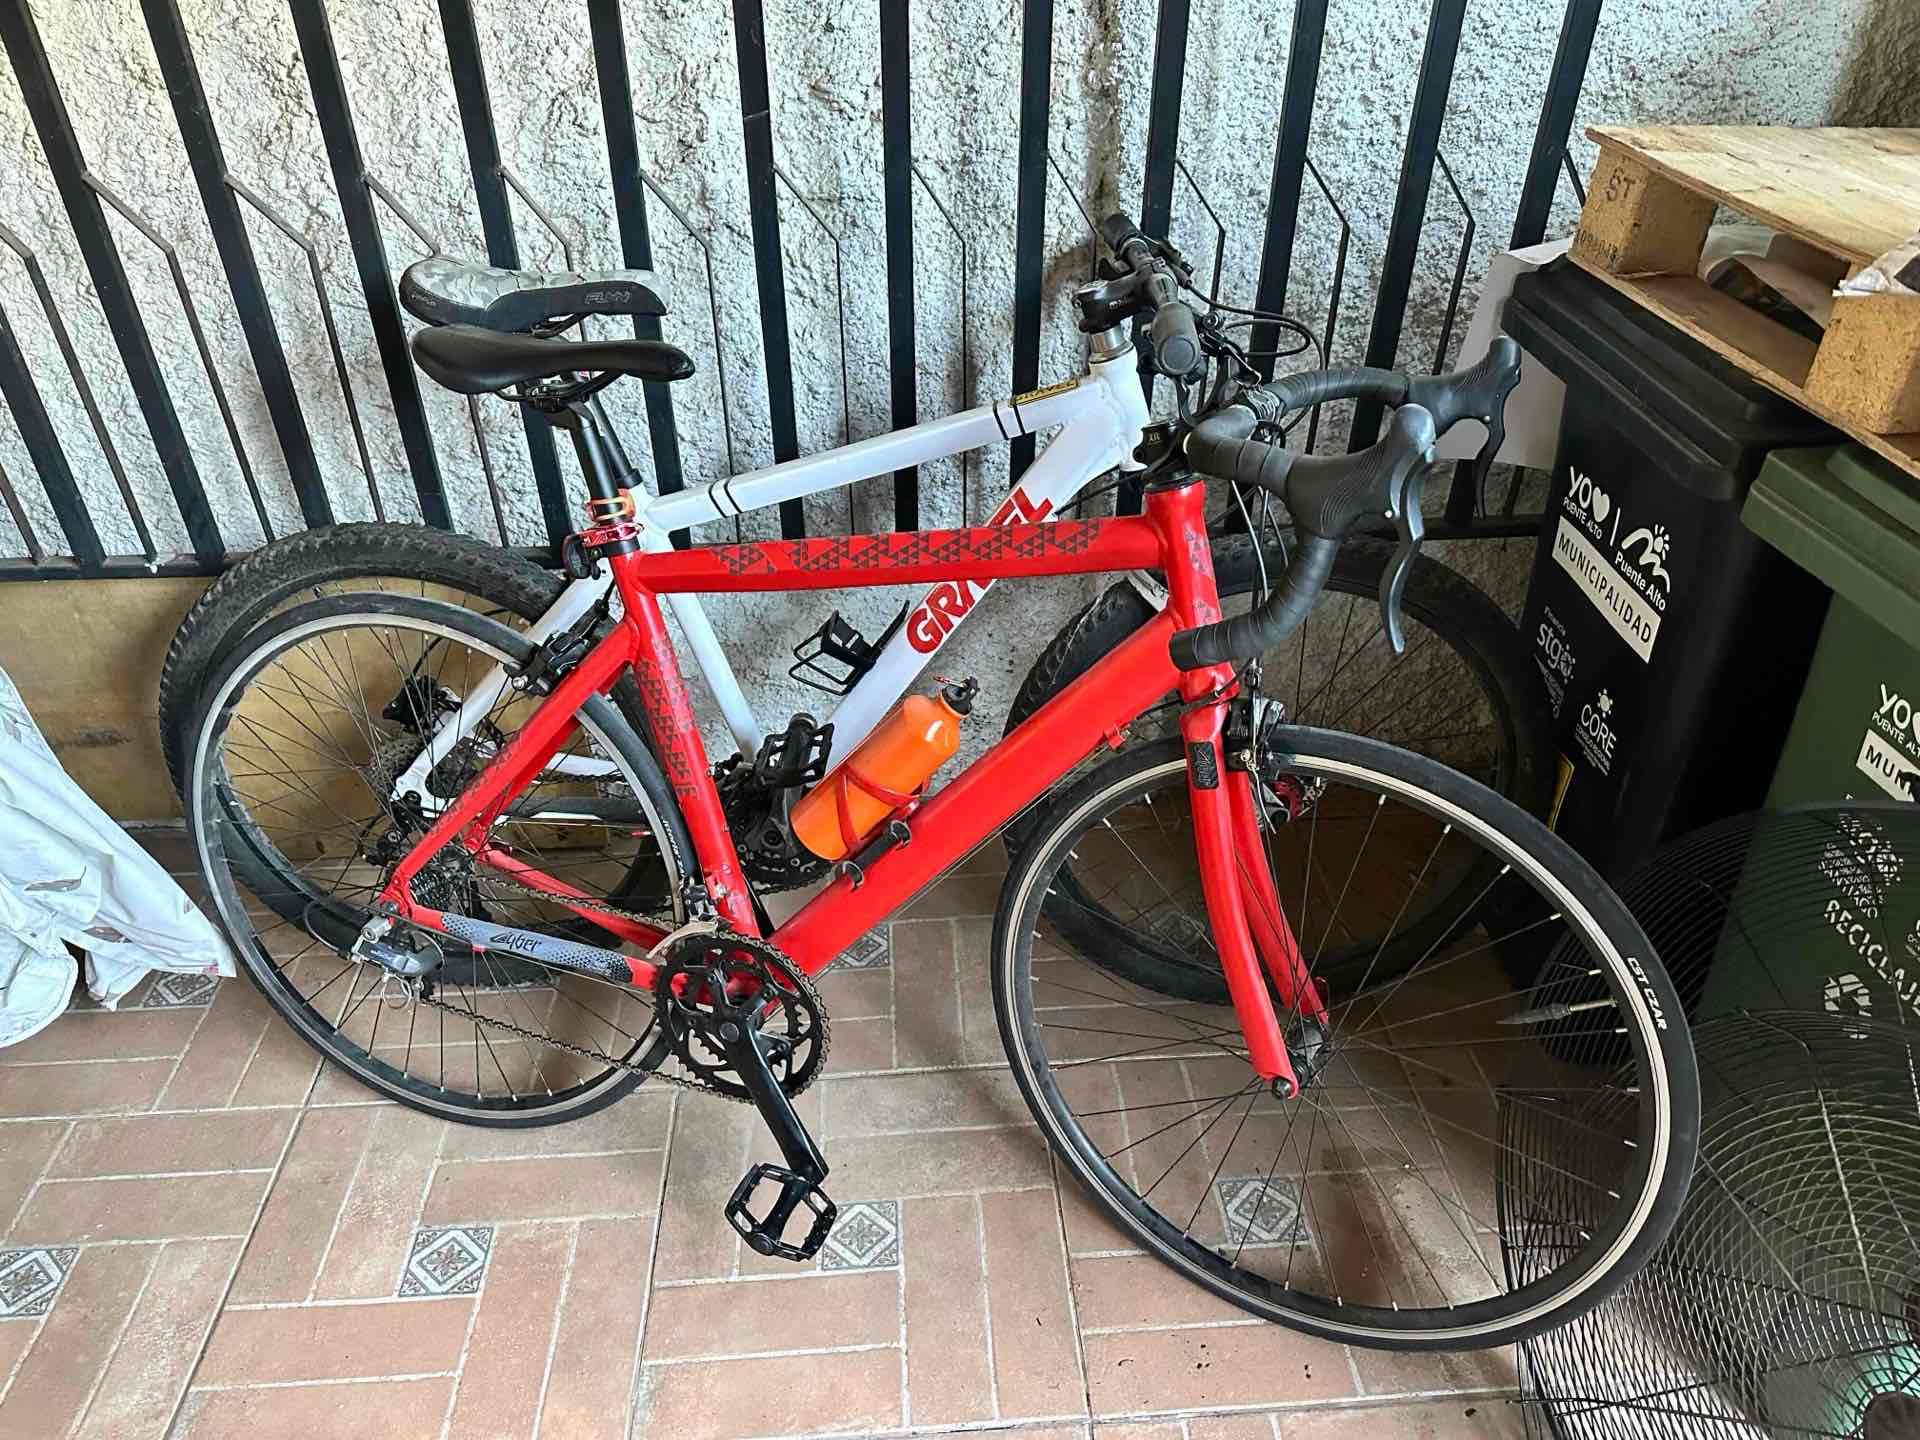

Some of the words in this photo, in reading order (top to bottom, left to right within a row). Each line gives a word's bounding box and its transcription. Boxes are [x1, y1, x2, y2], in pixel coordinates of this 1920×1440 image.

[1563, 496, 1588, 525] PUENTE
[1586, 518, 1603, 540] ALTO
[905, 486, 1054, 653] GRAEL
[1558, 532, 1651, 644] MUNICIPALIDAD
[1614, 551, 1646, 591] Puente
[1645, 583, 1666, 611] Alto
[1581, 704, 1617, 759] CORE
[1872, 711, 1906, 744] PUENTE
[1627, 957, 1650, 985] CST
[1643, 987, 1668, 1030] CZAR
